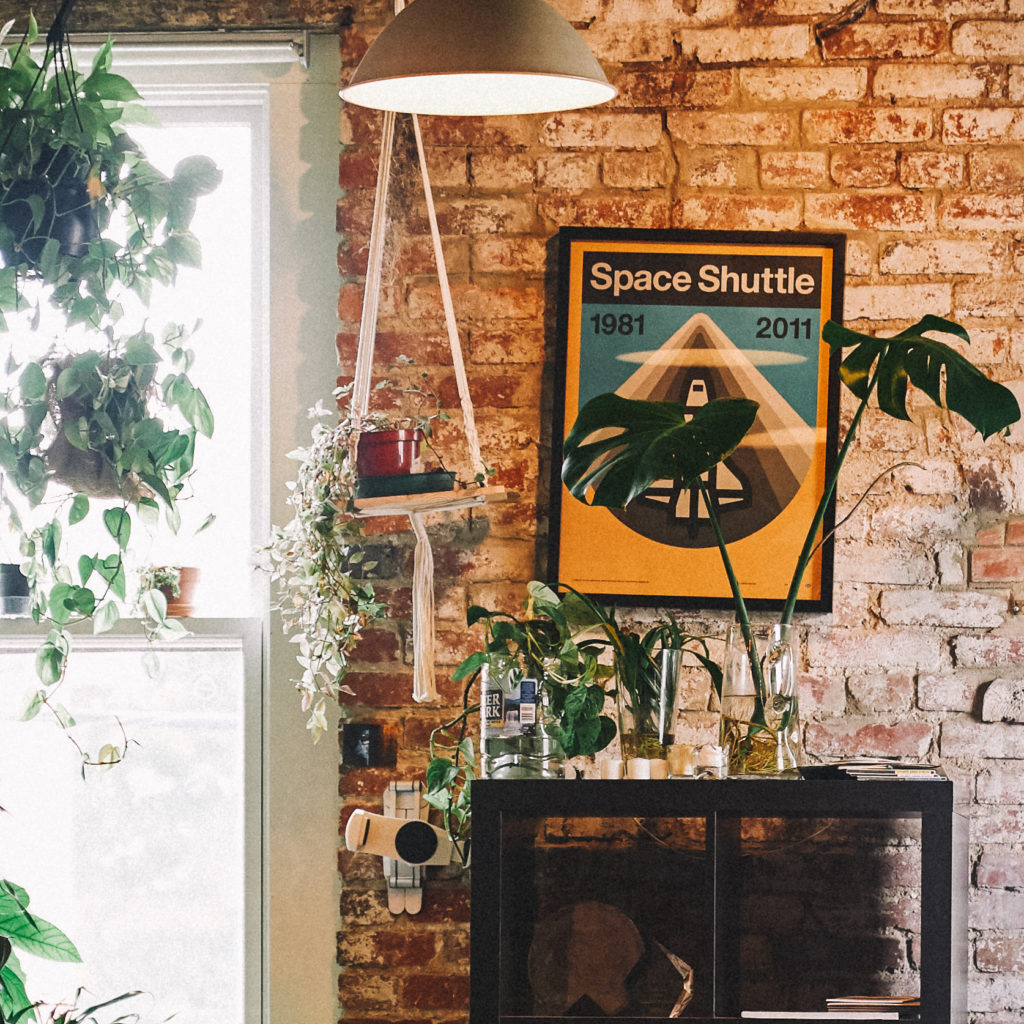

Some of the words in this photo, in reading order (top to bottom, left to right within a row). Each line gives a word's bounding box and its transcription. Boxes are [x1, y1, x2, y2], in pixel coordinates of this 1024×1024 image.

[589, 262, 692, 297] Space
[698, 264, 815, 296] Shuttle
[590, 313, 645, 336] 1981
[756, 317, 812, 340] 2011
